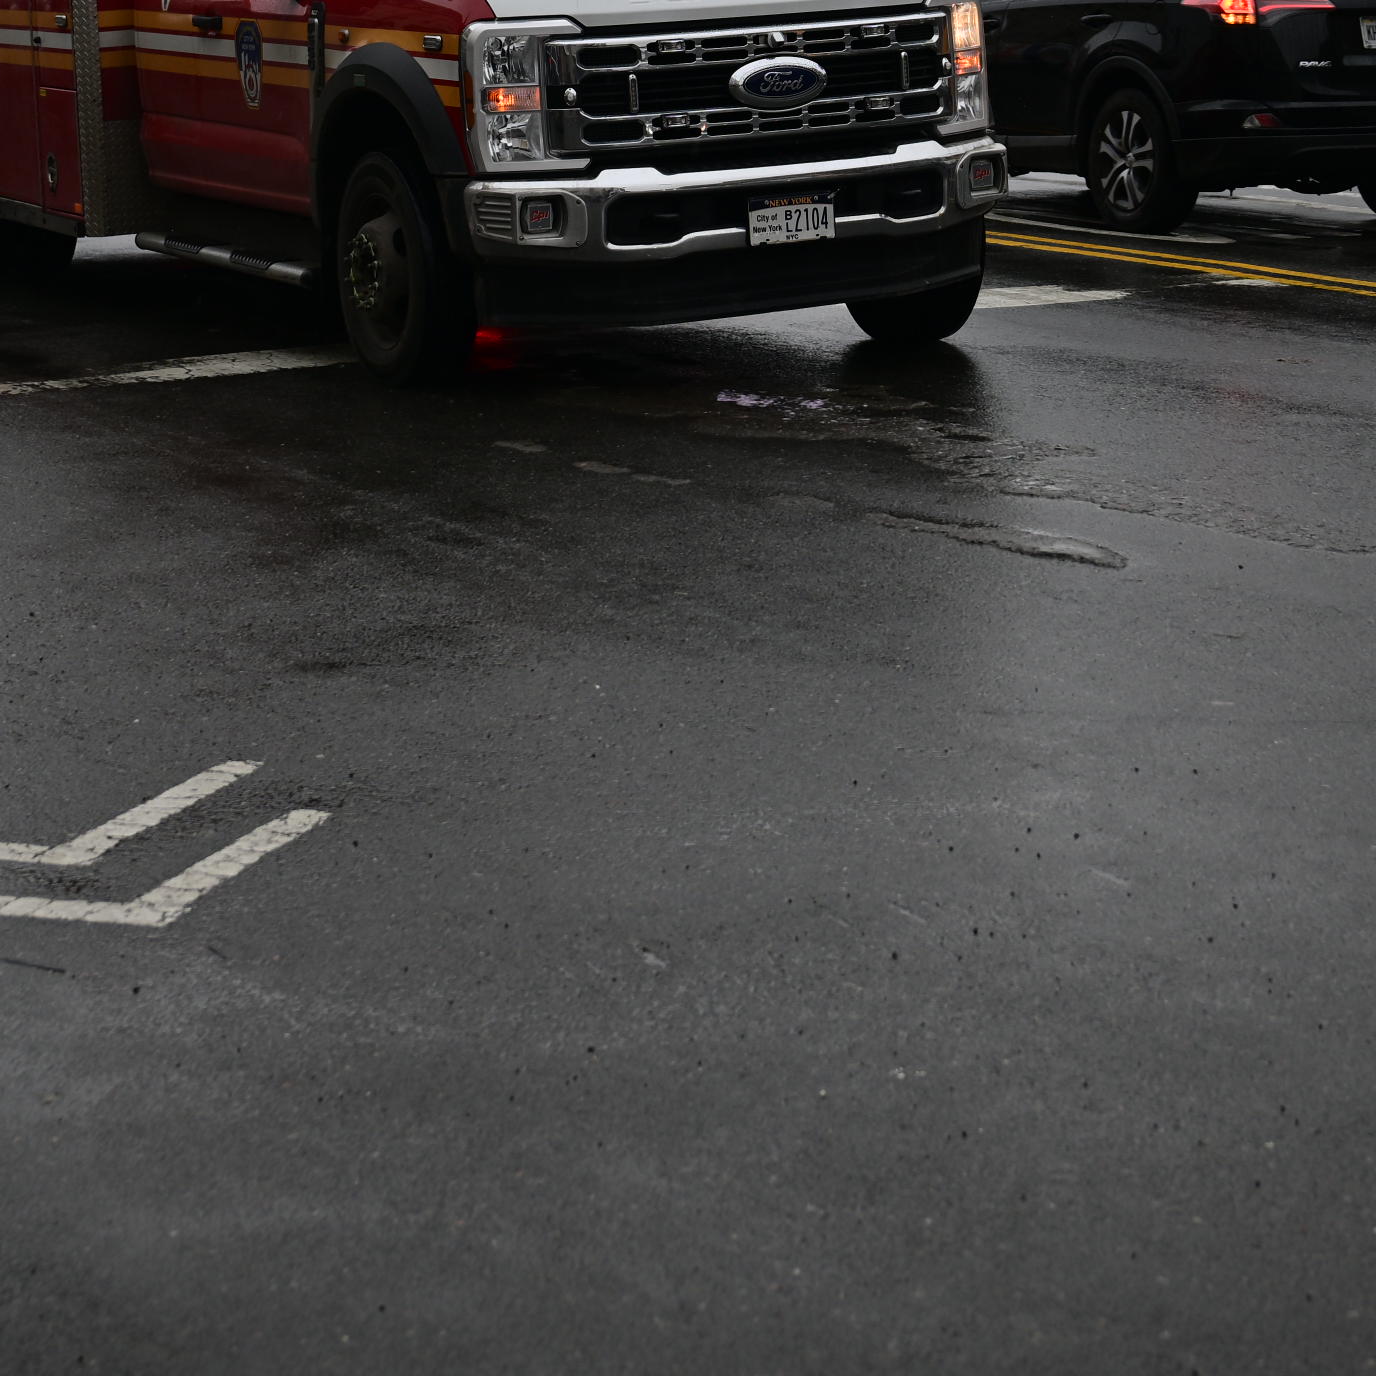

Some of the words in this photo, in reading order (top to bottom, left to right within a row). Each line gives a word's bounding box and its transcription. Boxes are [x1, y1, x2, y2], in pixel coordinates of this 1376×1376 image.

[760, 71, 804, 93] Ford
[768, 198, 788, 208] NEW
[791, 196, 812, 204] YORK
[756, 214, 770, 223] City
[752, 226, 766, 234] New
[768, 224, 782, 232] York
